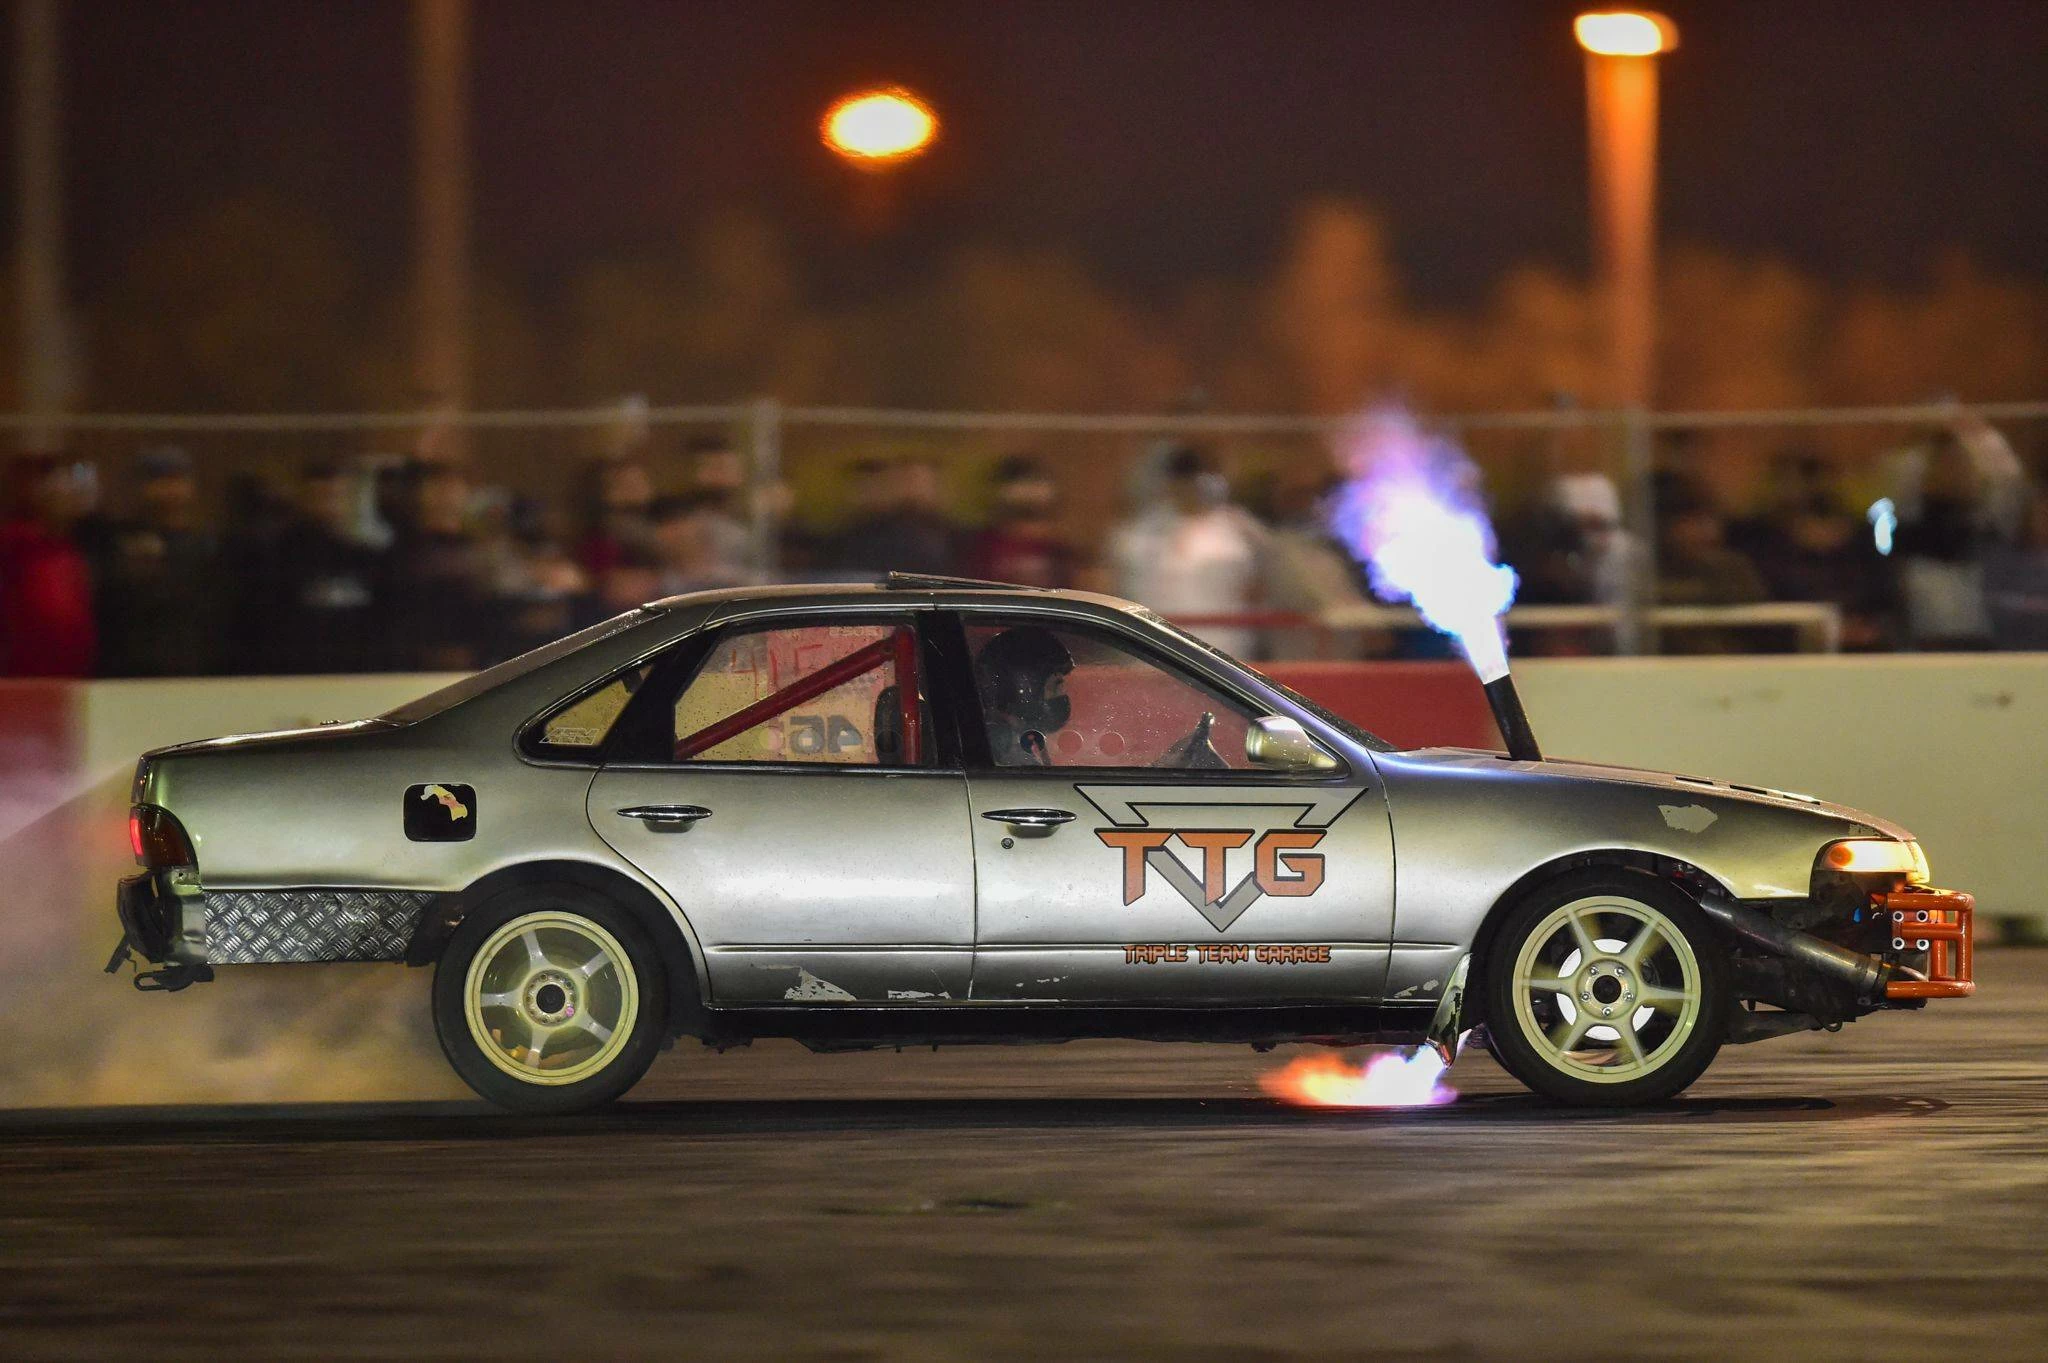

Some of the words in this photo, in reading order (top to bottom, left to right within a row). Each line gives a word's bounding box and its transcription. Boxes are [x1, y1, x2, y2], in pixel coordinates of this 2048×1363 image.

[1094, 828, 1327, 906] TTG
[1121, 943, 1189, 964] TRIPLE
[1195, 944, 1249, 964] TEAM
[1254, 945, 1332, 964] GARAGE
